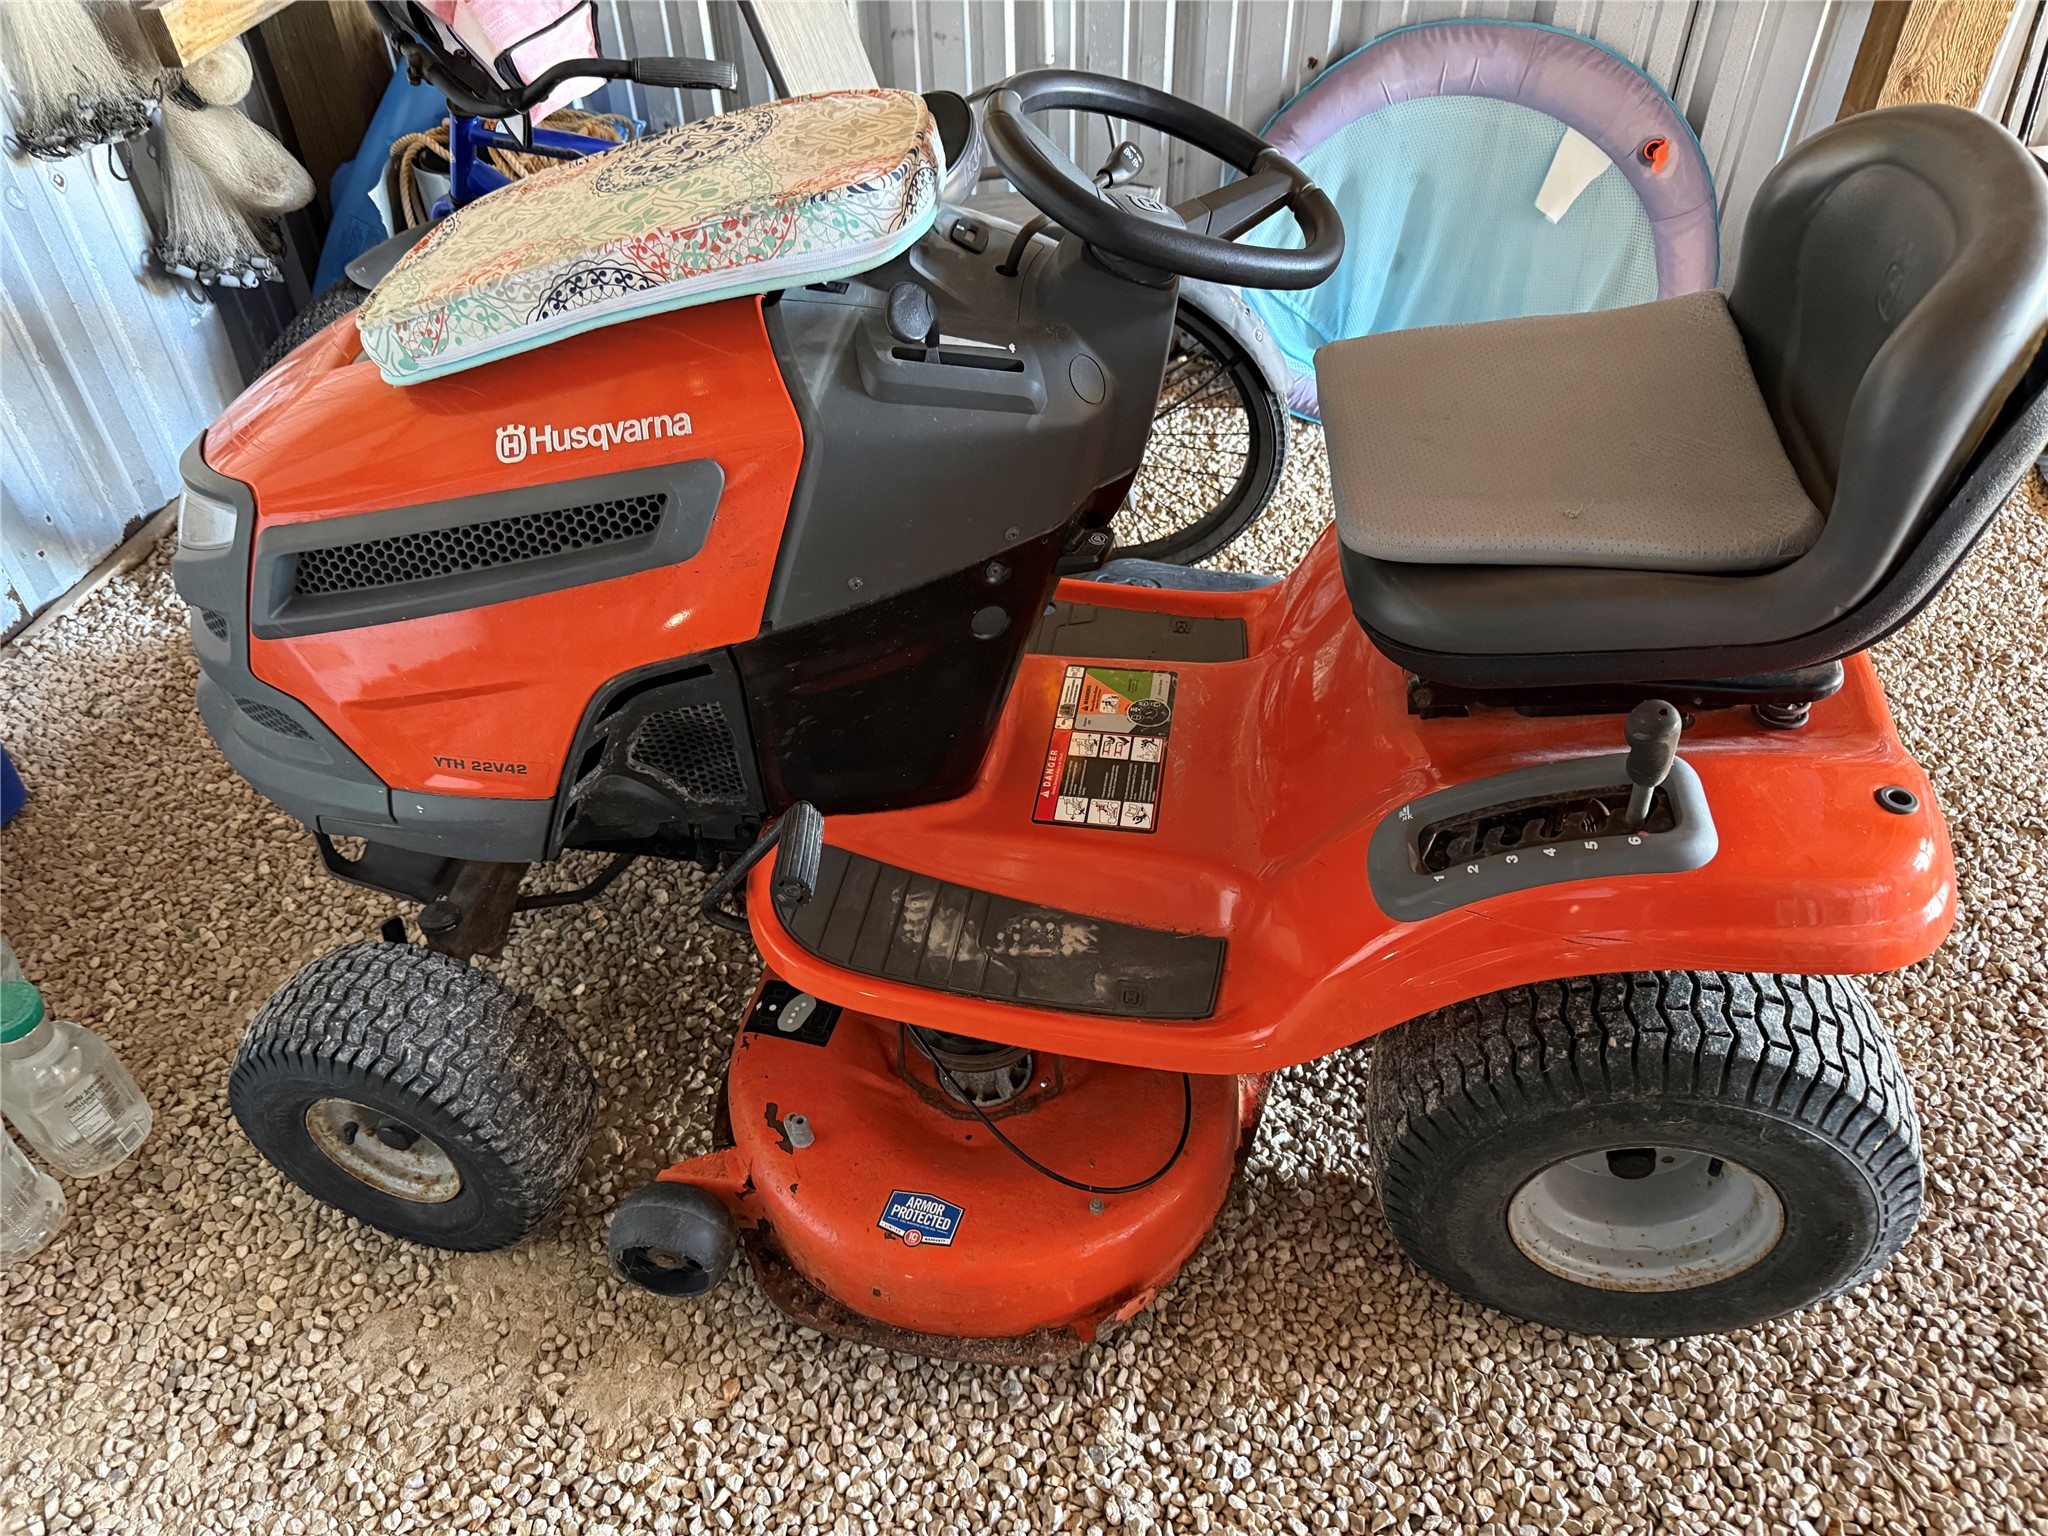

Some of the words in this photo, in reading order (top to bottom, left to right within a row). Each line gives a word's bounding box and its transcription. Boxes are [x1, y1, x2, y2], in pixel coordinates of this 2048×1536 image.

[529, 412, 693, 455] Husqvarna
[433, 756, 465, 769] YTH
[471, 761, 528, 775] 22V42
[1043, 750, 1058, 787] DANGER
[1433, 874, 1445, 882] 1
[1467, 863, 1479, 874] 2
[1506, 854, 1518, 864] 3
[1543, 847, 1556, 857] 4
[1584, 841, 1598, 850] 5
[1627, 836, 1642, 845] 6
[890, 1204, 951, 1230] PROTECTED
[905, 1196, 946, 1216] ARMOR
